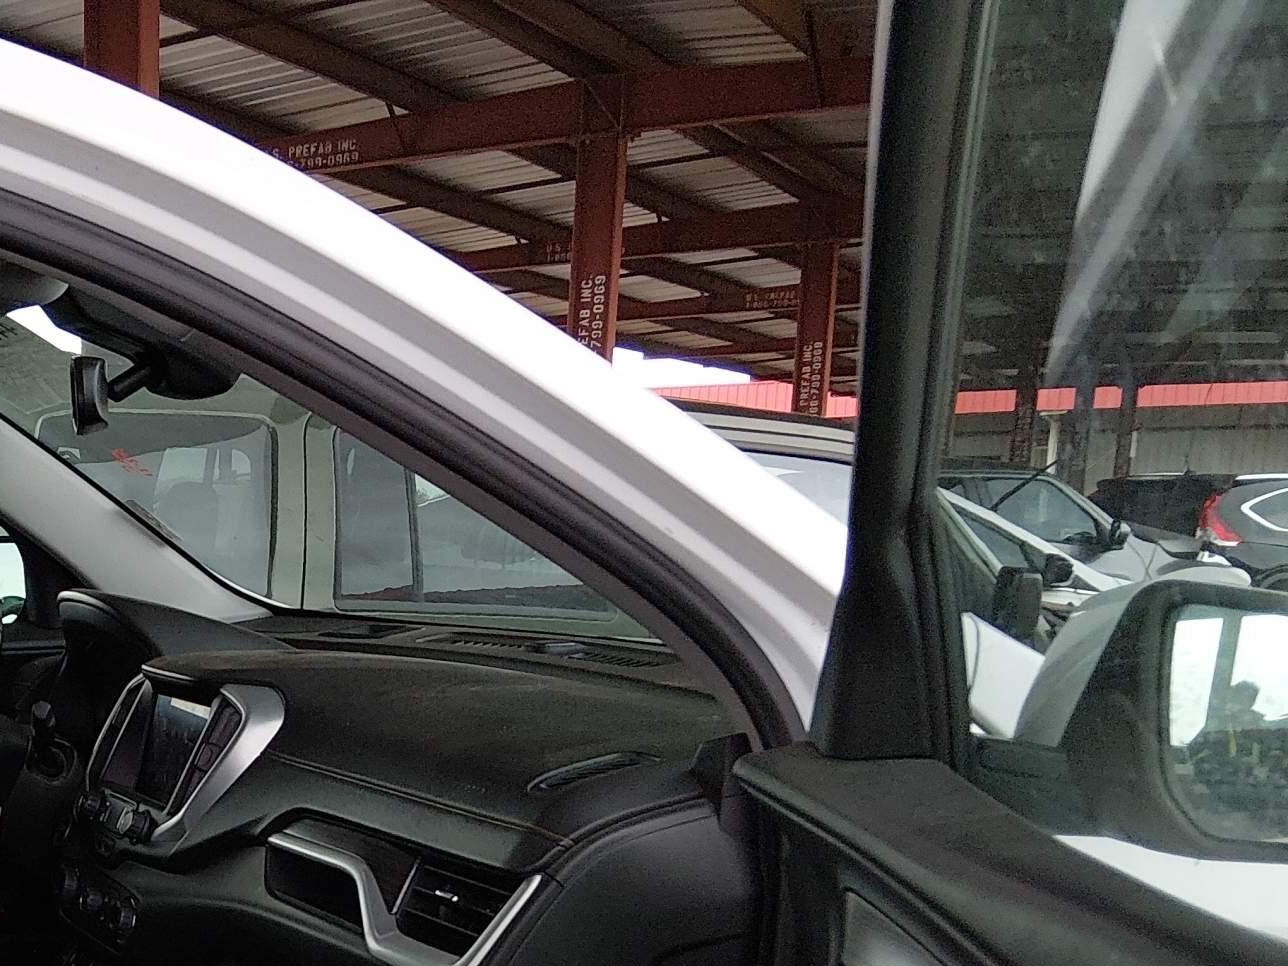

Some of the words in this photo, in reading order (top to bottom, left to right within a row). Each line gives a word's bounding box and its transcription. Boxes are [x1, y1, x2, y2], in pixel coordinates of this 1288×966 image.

[288, 141, 332, 158] PREFAB
[578, 309, 591, 345] EFAB
[591, 275, 606, 350] 799-0969
